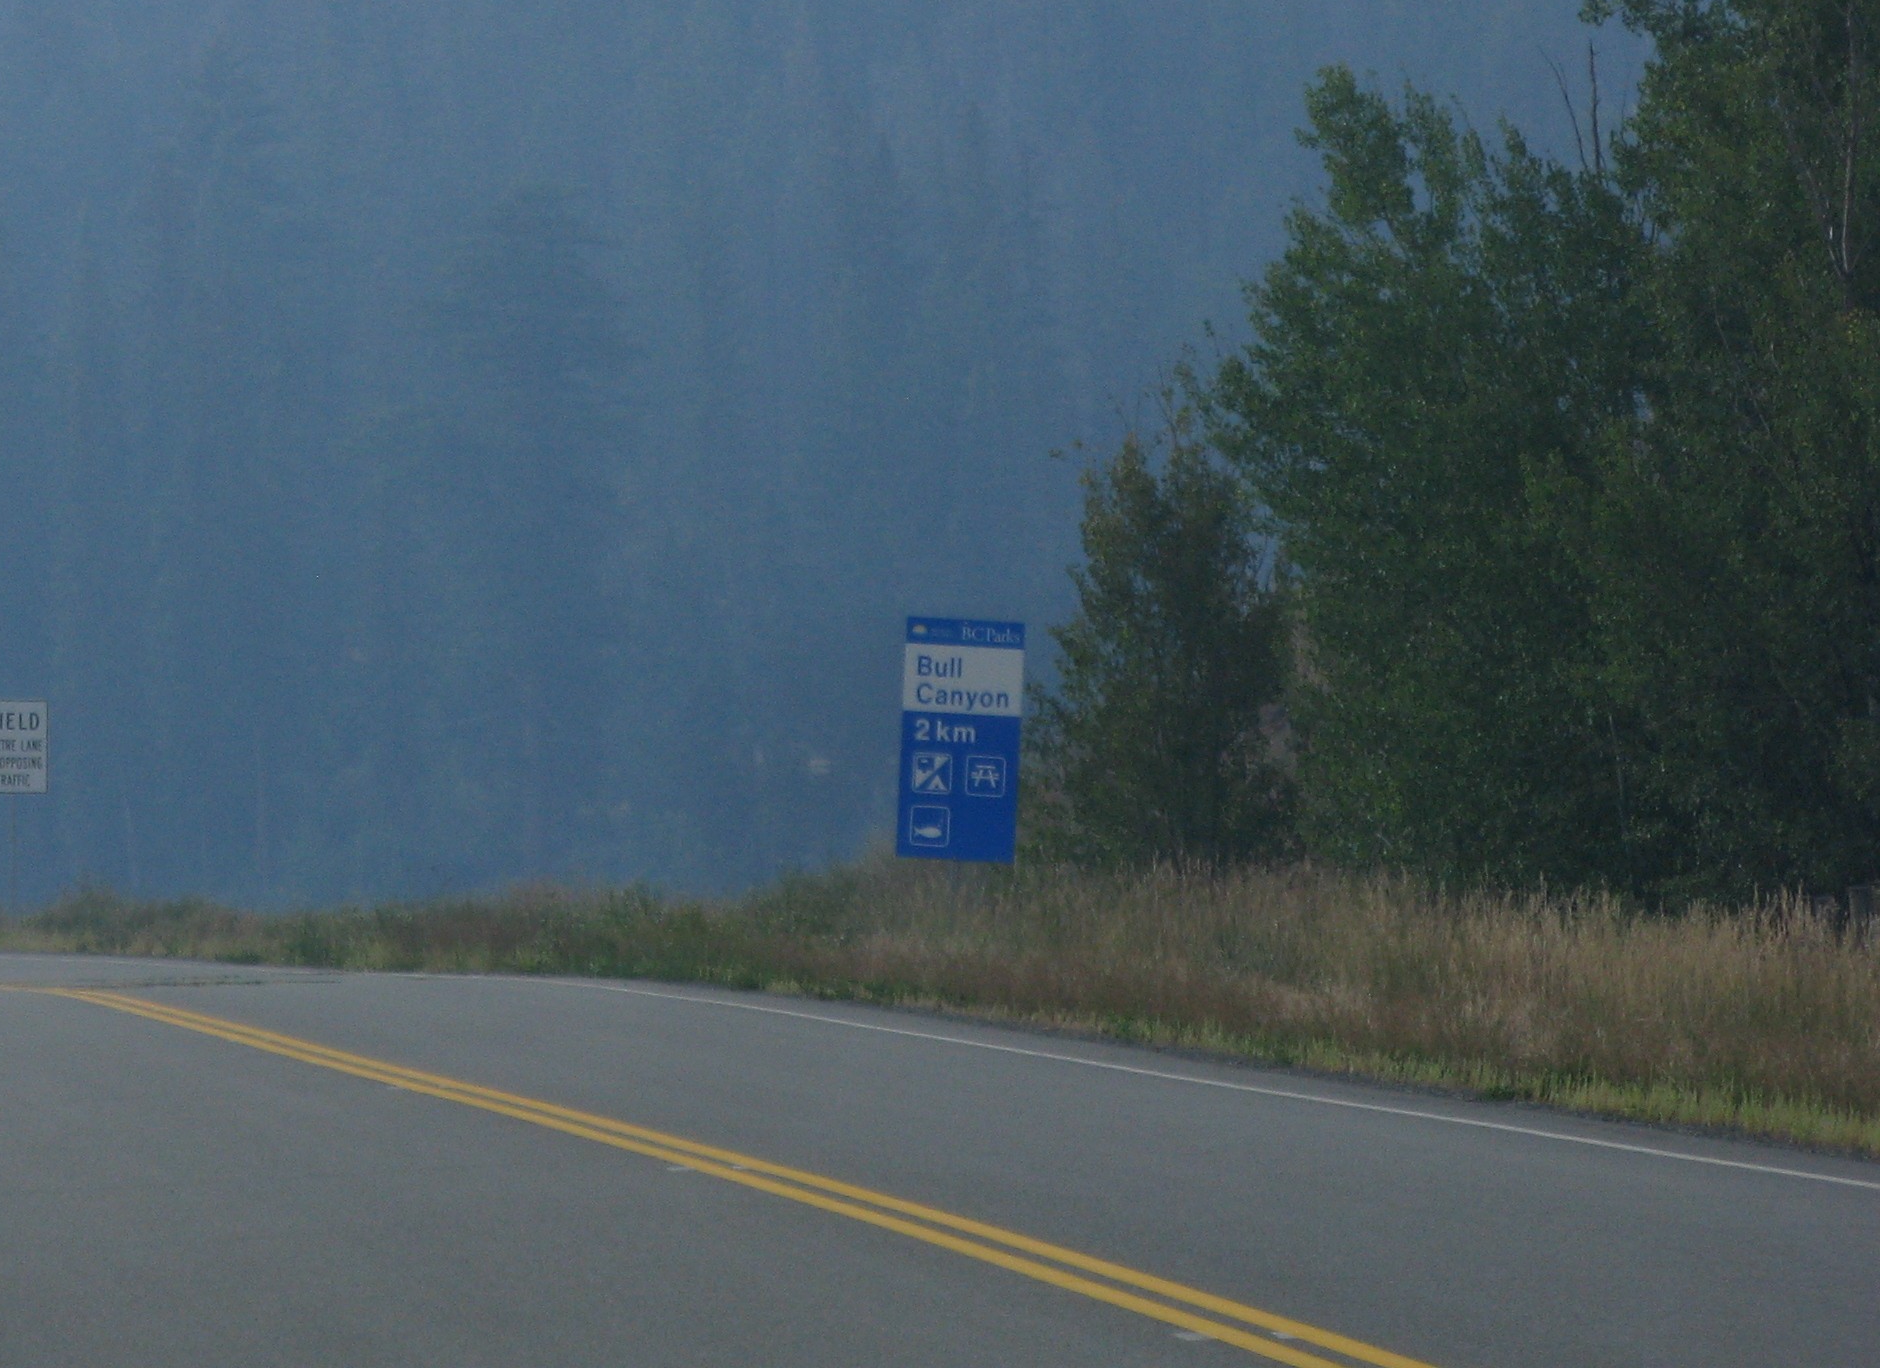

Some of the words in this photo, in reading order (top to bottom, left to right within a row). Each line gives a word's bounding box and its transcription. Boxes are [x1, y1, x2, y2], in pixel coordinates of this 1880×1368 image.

[987, 627, 1020, 643] Parks
[917, 655, 962, 678] Bull
[917, 683, 1009, 711] Canyon
[915, 718, 930, 741] 2
[936, 720, 977, 743] km
[21, 739, 42, 752] LANE
[0, 757, 42, 769] OPPOSING
